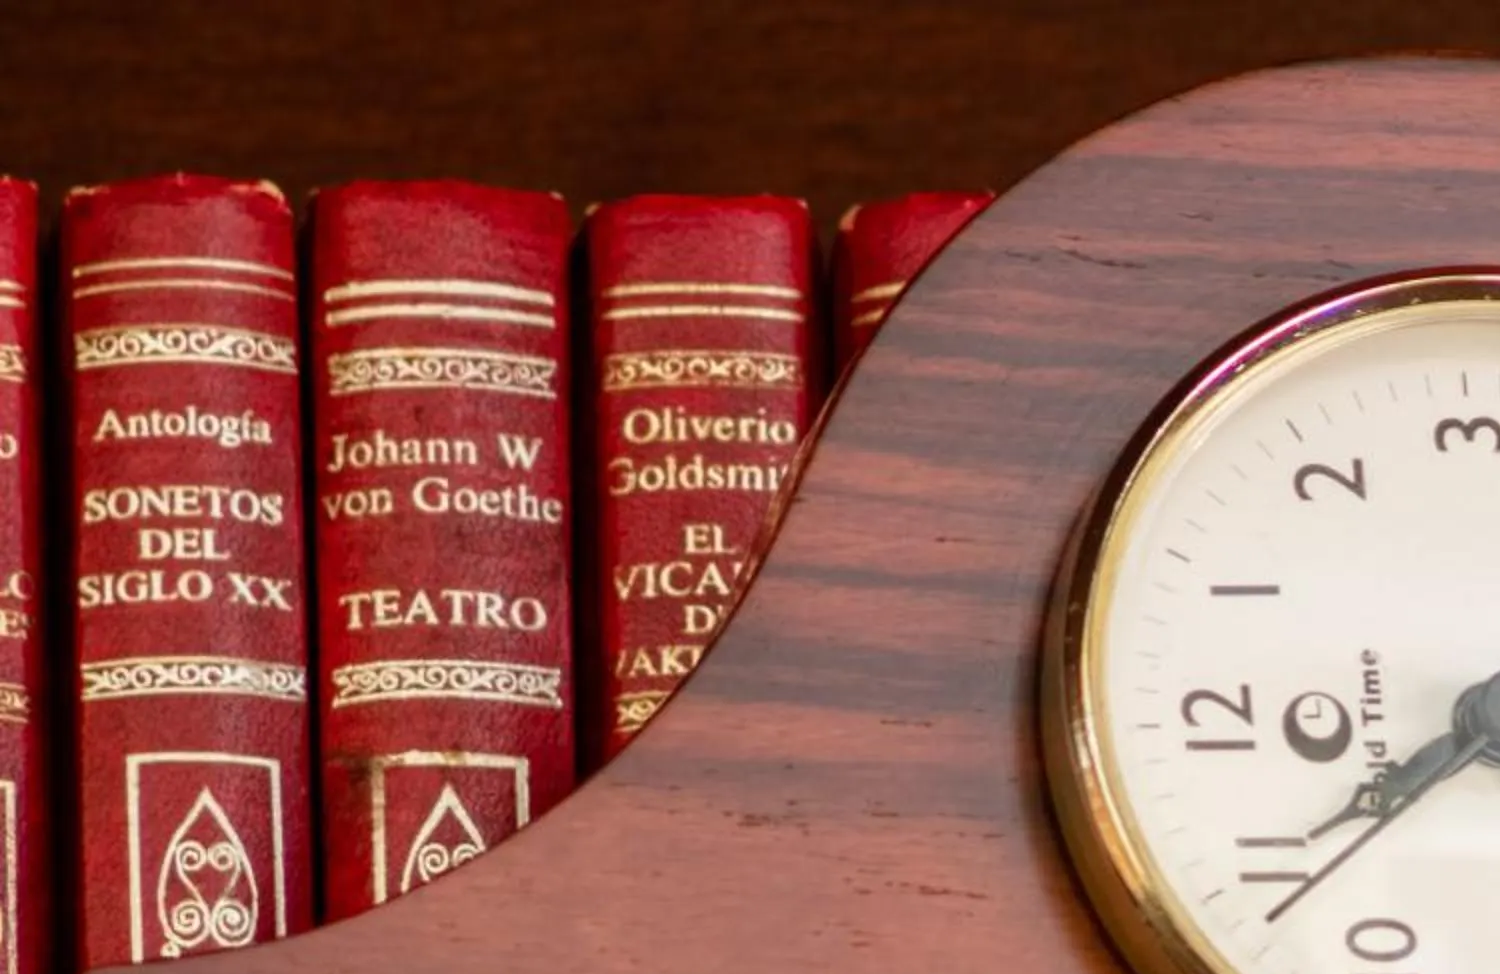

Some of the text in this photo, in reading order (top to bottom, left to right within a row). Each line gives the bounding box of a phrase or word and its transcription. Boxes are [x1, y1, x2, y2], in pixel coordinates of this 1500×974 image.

[94, 404, 273, 449] Antología
[623, 406, 796, 445] Oliverio
[328, 428, 542, 472] Johann W
[606, 452, 789, 496] Goldsmi
[1293, 458, 1366, 501] 2
[83, 484, 284, 526] SONETOS
[326, 476, 562, 524] von Goethe
[139, 528, 231, 561] DEL
[685, 524, 736, 554] EL
[79, 569, 214, 608] SIGLO
[227, 572, 292, 611] XX
[612, 558, 742, 602] VICA
[1210, 585, 1281, 596] 1
[339, 588, 548, 631] TEATRO
[683, 604, 725, 634] D
[1360, 649, 1384, 727] Time
[1181, 684, 1256, 751] 12
[1235, 837, 1310, 883] 11
